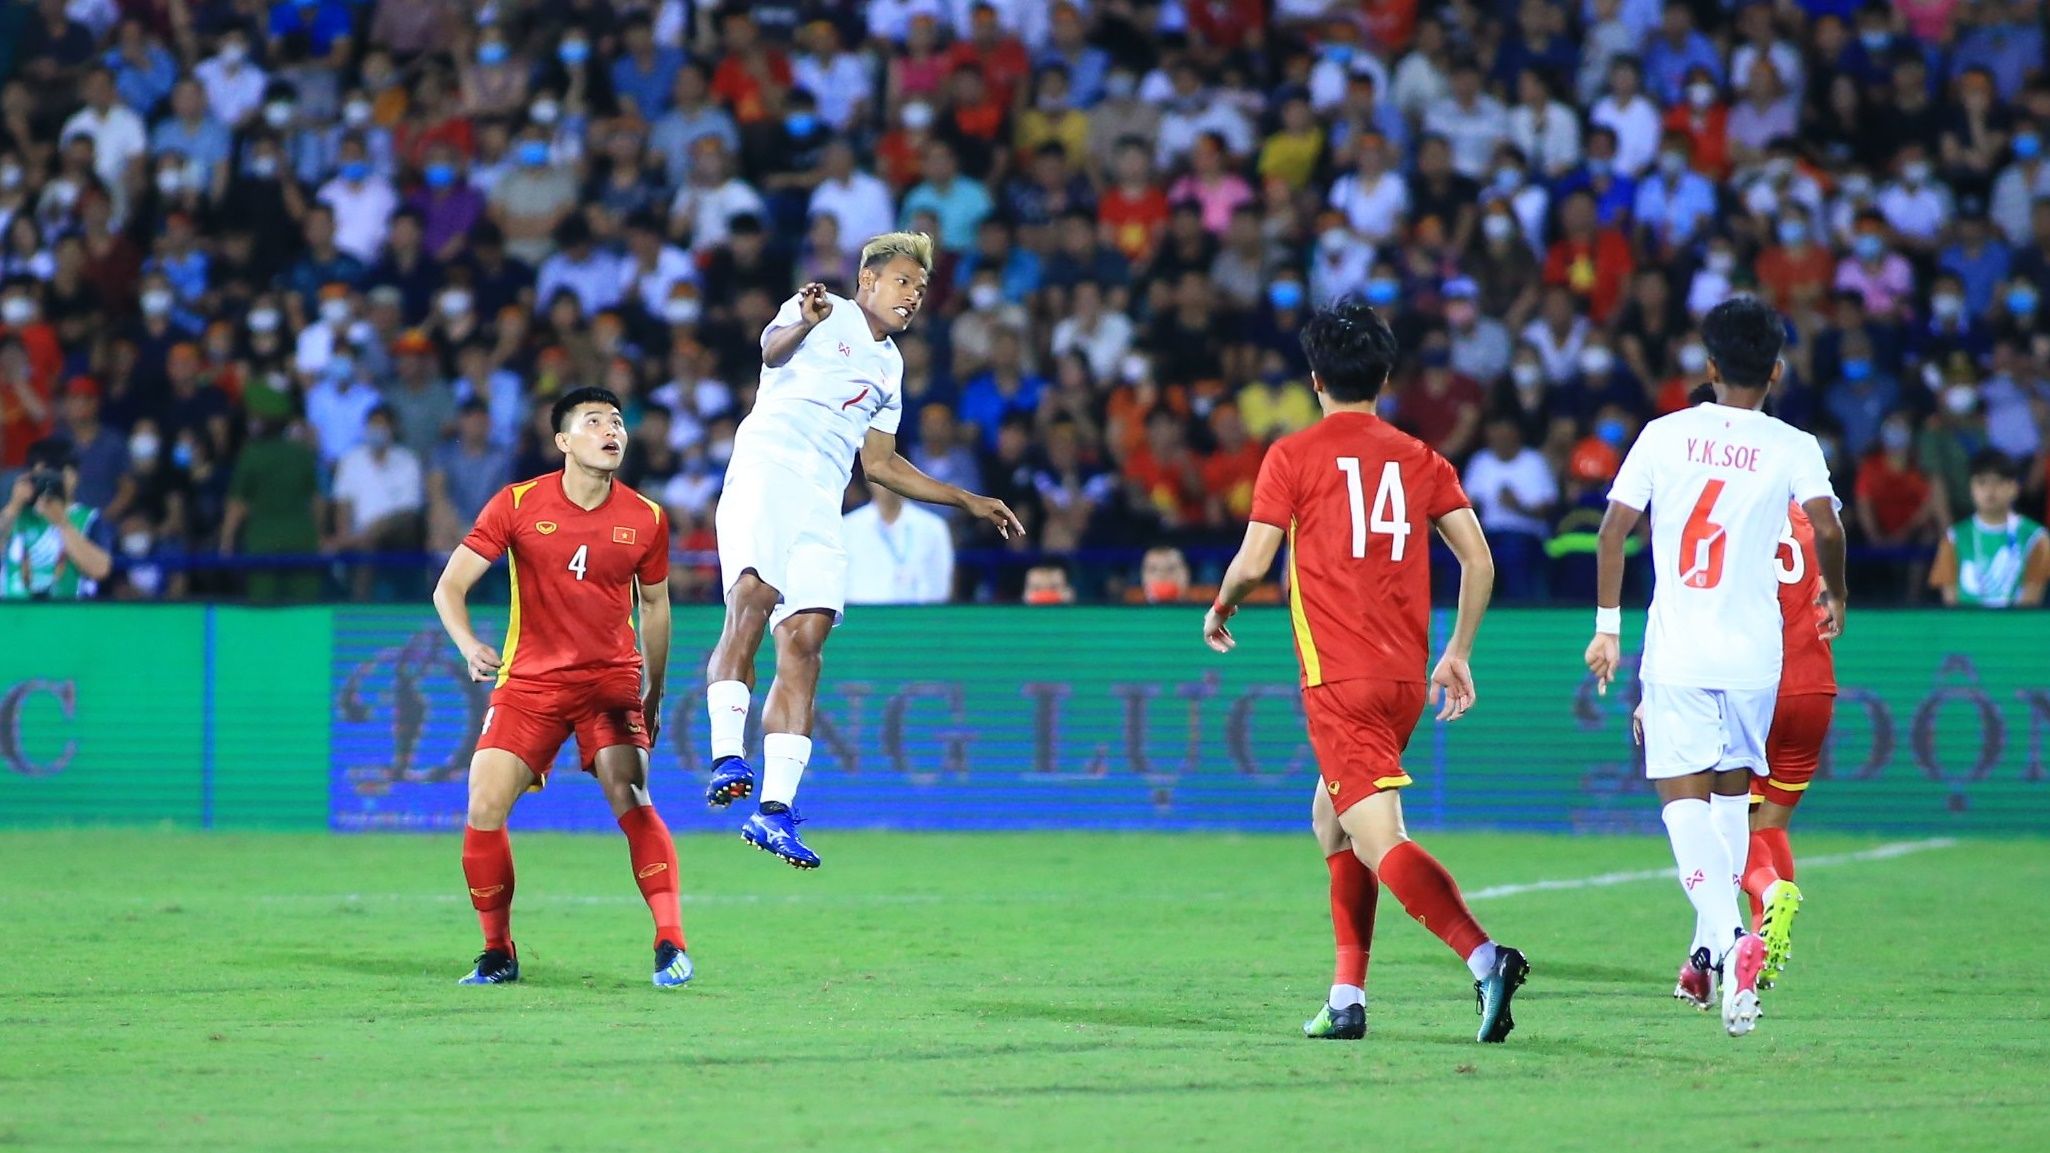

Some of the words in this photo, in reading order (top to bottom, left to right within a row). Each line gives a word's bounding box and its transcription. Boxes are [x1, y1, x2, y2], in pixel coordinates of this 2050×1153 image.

[1686, 437, 1761, 472] Y.K.SOE
[1336, 456, 1411, 561] 14
[1679, 478, 1727, 589] 6
[568, 544, 588, 581] 4
